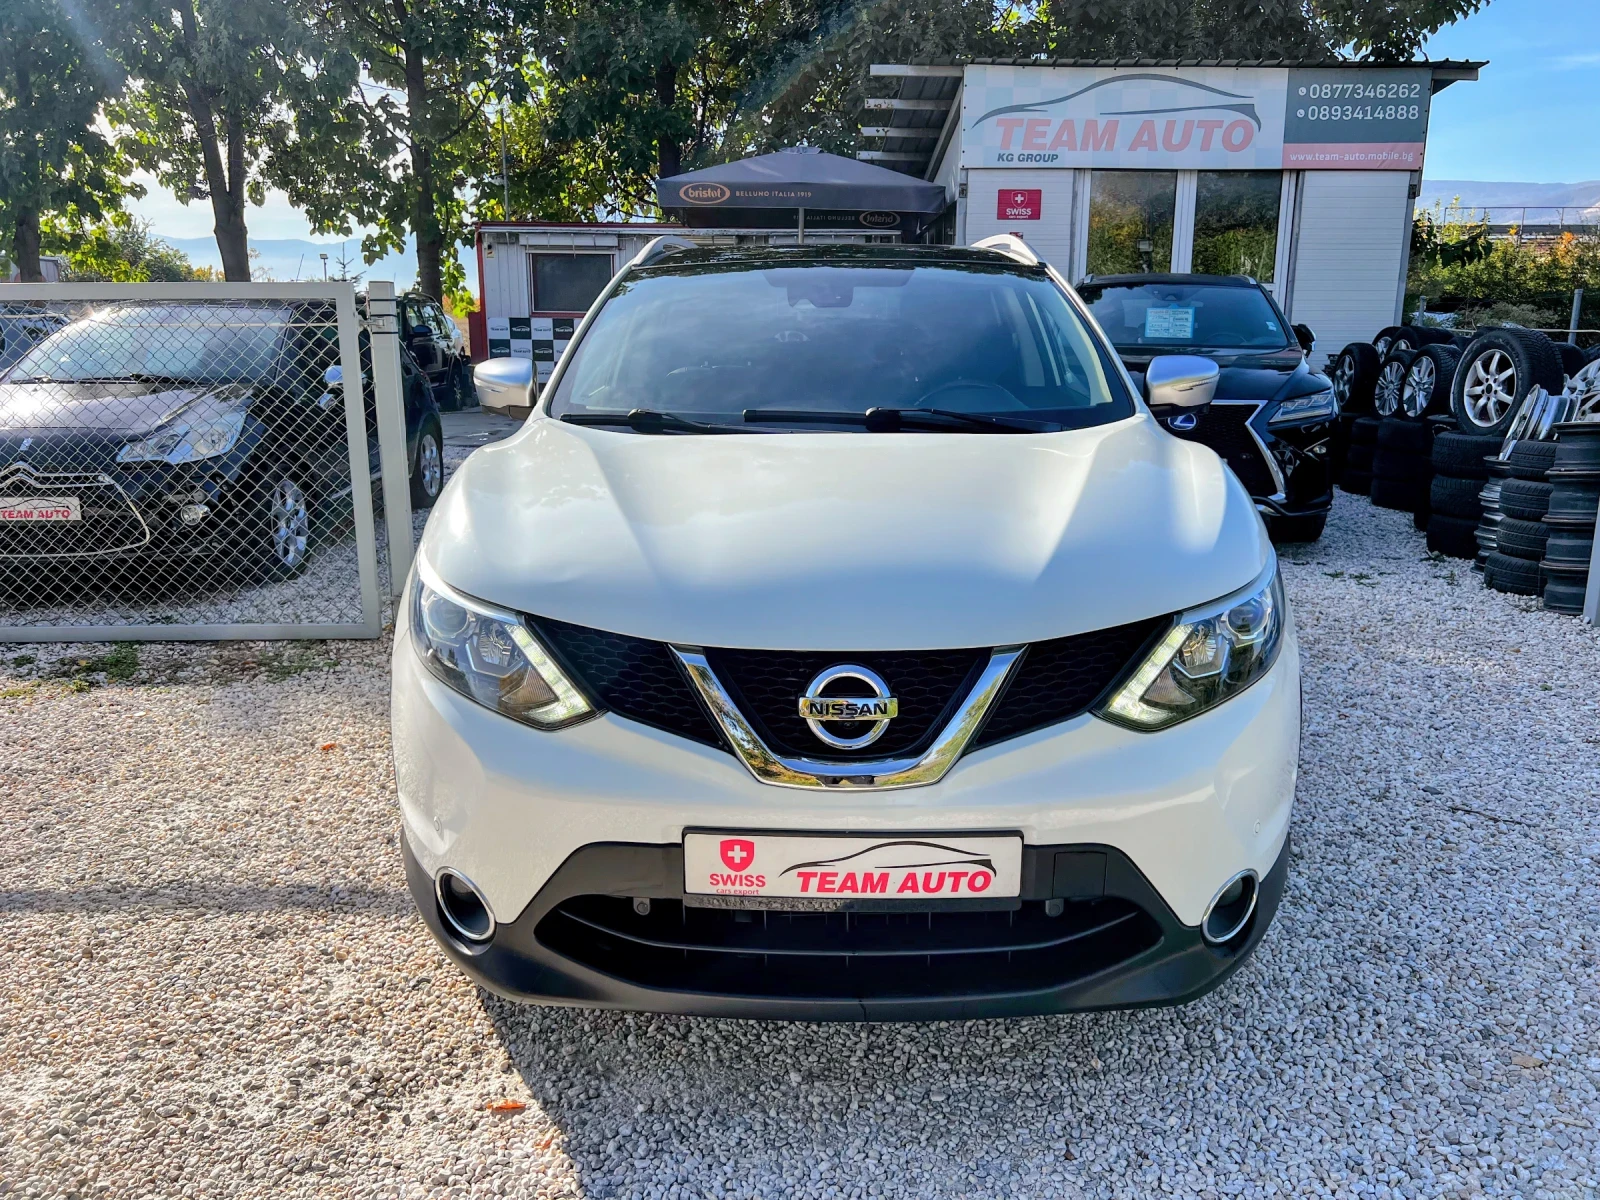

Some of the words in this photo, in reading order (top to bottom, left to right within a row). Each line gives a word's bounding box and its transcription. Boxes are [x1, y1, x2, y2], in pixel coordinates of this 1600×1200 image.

[1309, 83, 1421, 99] 0877346262
[1307, 105, 1419, 120] 0893414888
[996, 118, 1119, 151] TEAM
[1128, 119, 1255, 153] AUTO
[997, 152, 1014, 163] KG
[1017, 153, 1059, 163] GROUP
[1290, 151, 1414, 162] www.team-auto.mobile.bg
[1, 510, 33, 519] TEAM
[38, 509, 71, 519] AUTO
[809, 702, 888, 716] NISSAN
[709, 873, 766, 888] SWISS
[797, 871, 890, 894] TEAM
[896, 871, 992, 894] AUTO
